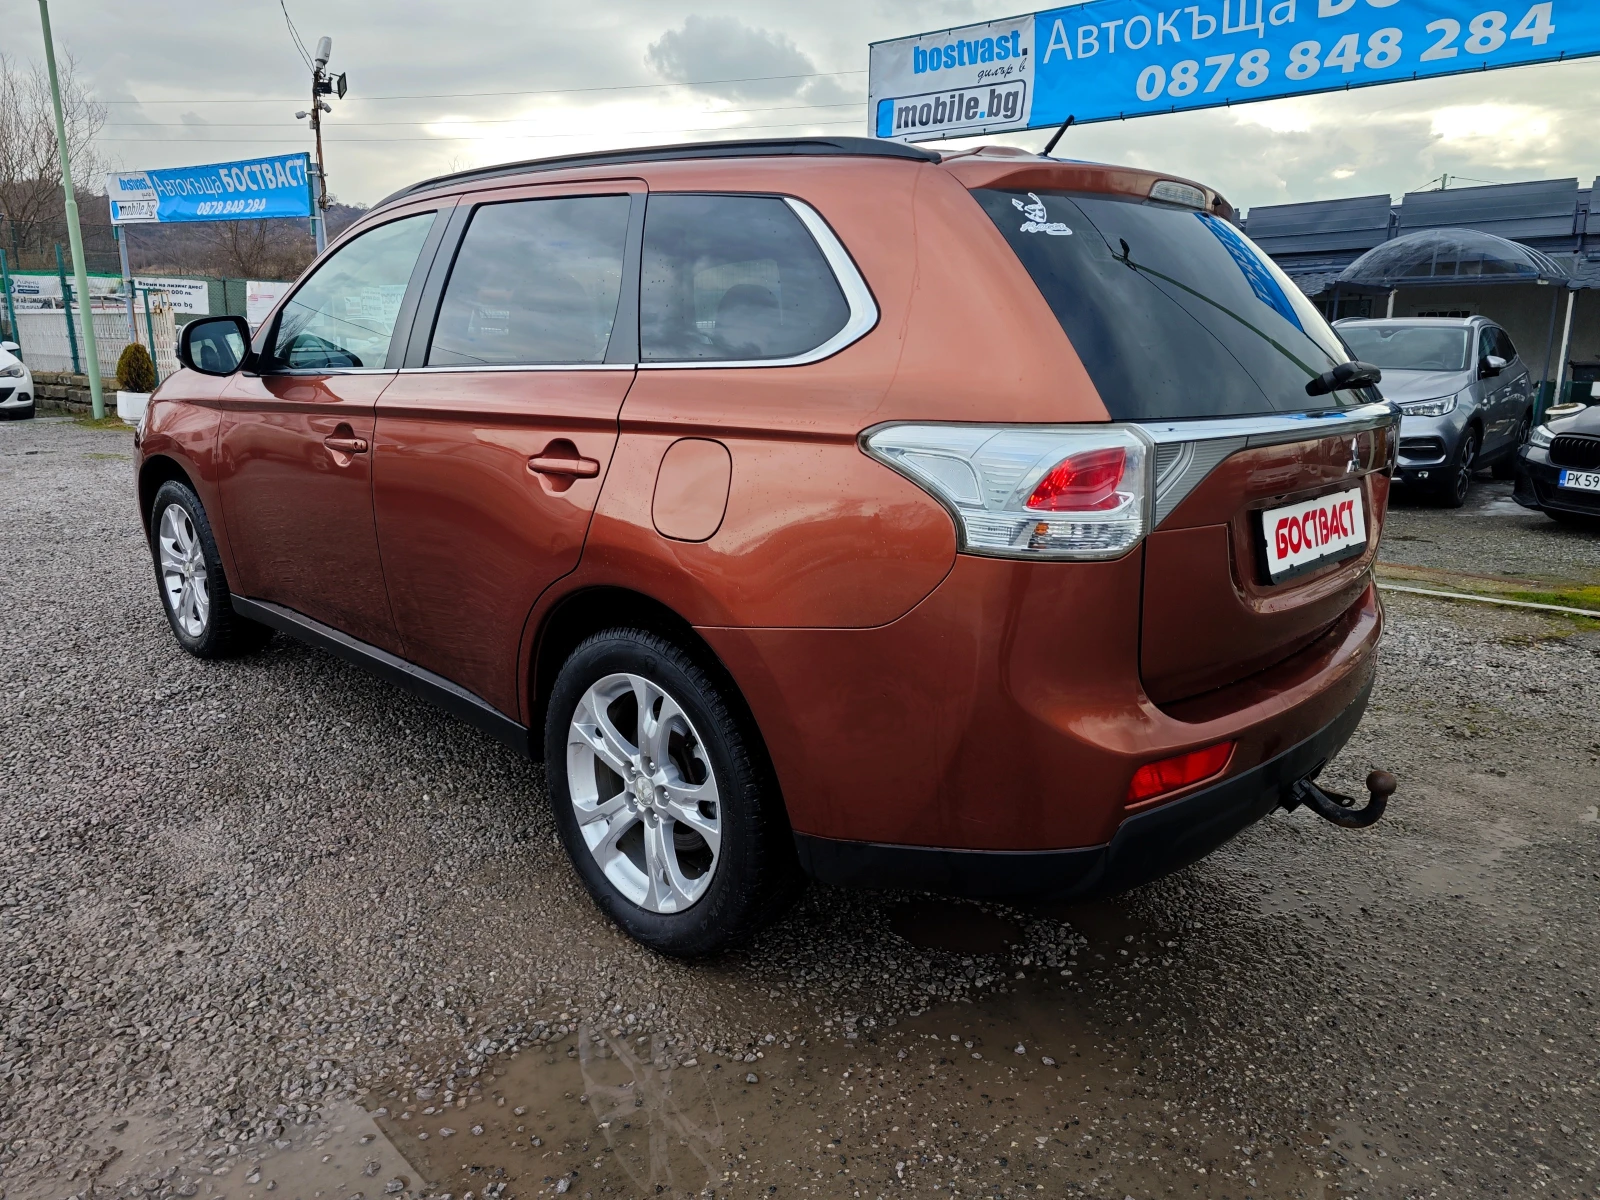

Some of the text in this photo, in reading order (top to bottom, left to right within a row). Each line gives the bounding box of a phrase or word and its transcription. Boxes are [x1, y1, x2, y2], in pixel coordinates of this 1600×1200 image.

[913, 30, 1028, 74] bostvast.
[1136, 2, 1556, 102] 0878 848 284
[896, 89, 1019, 129] mobile.bg
[218, 159, 304, 193] БОСТВАСТ
[196, 198, 266, 215] 0878 848 284
[1566, 473, 1582, 486] PK
[1275, 500, 1355, 560] БОСТВАСТ
